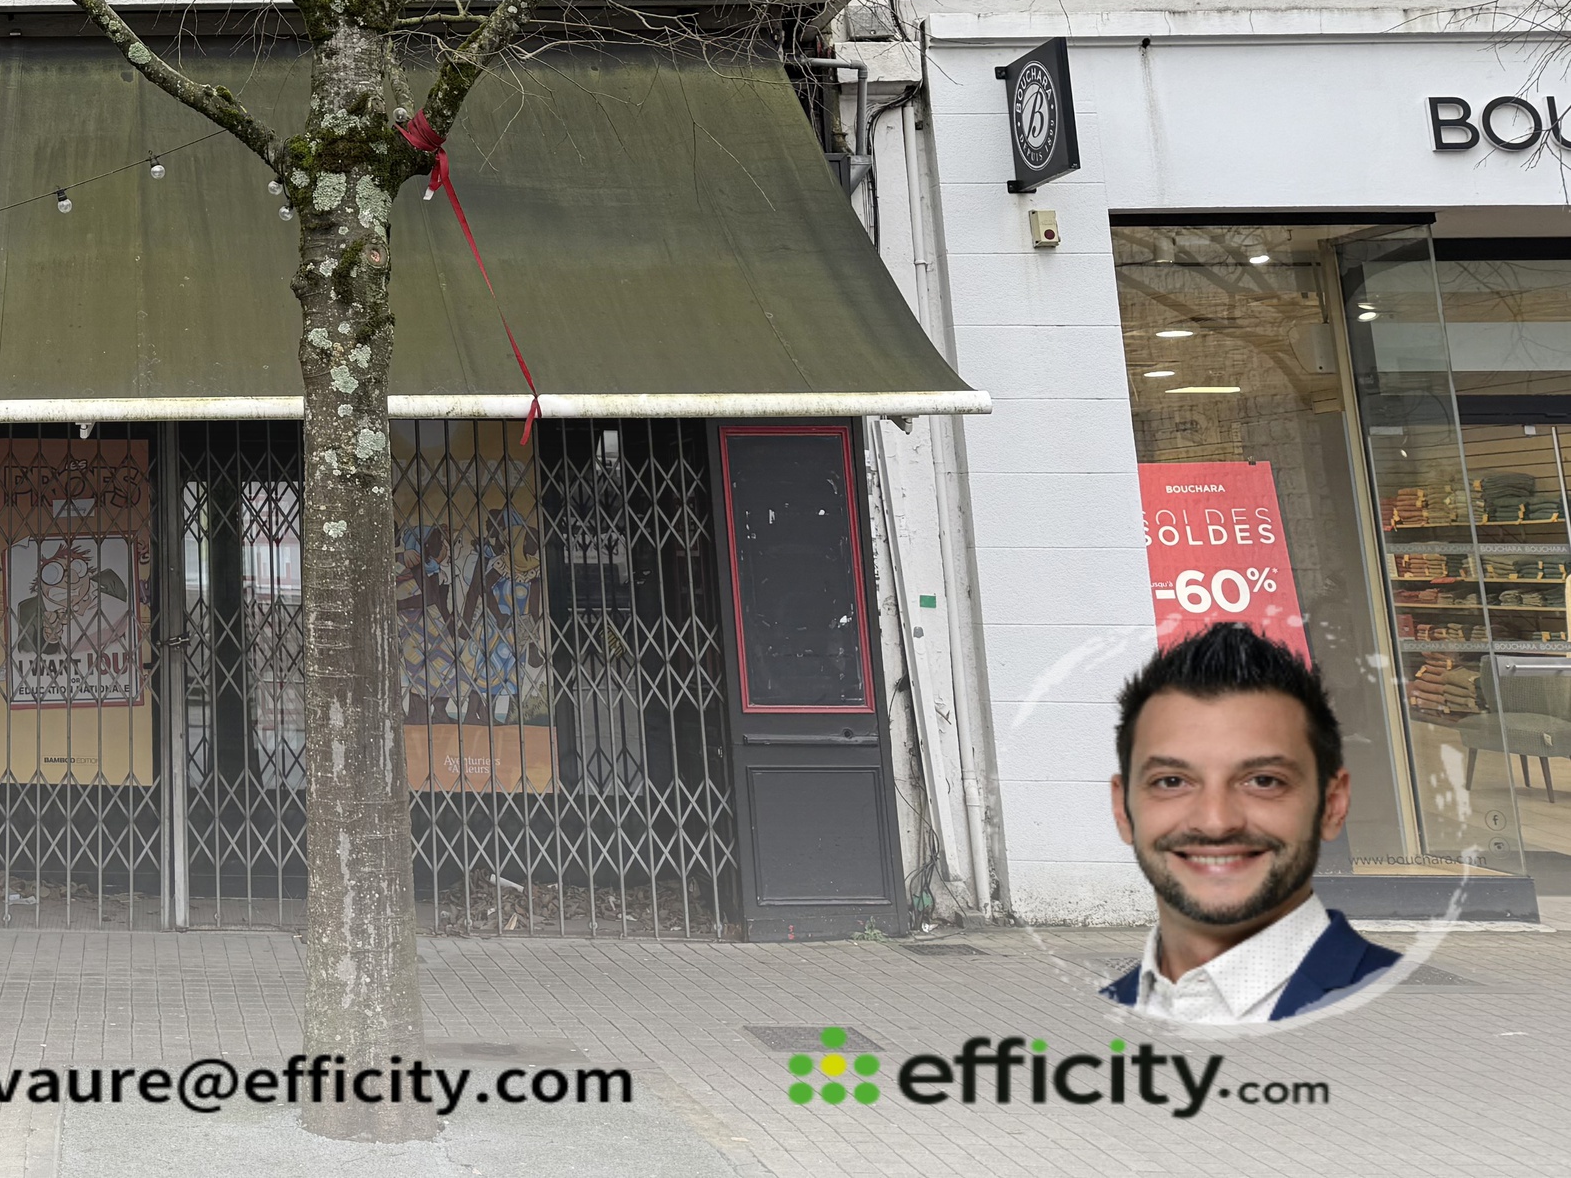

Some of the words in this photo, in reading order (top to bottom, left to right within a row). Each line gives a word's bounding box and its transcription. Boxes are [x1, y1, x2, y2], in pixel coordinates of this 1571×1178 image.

[1016, 68, 1051, 113] BOUCHARA
[3, 465, 141, 509] PROFS
[1165, 484, 1226, 494] BOUCHARA
[1150, 580, 1174, 588] usqu'à
[29, 658, 82, 677] WANT
[76, 684, 130, 694] NATIONAE
[443, 754, 501, 766] Aventuries
[1348, 853, 1487, 866] www.bouchara.com
